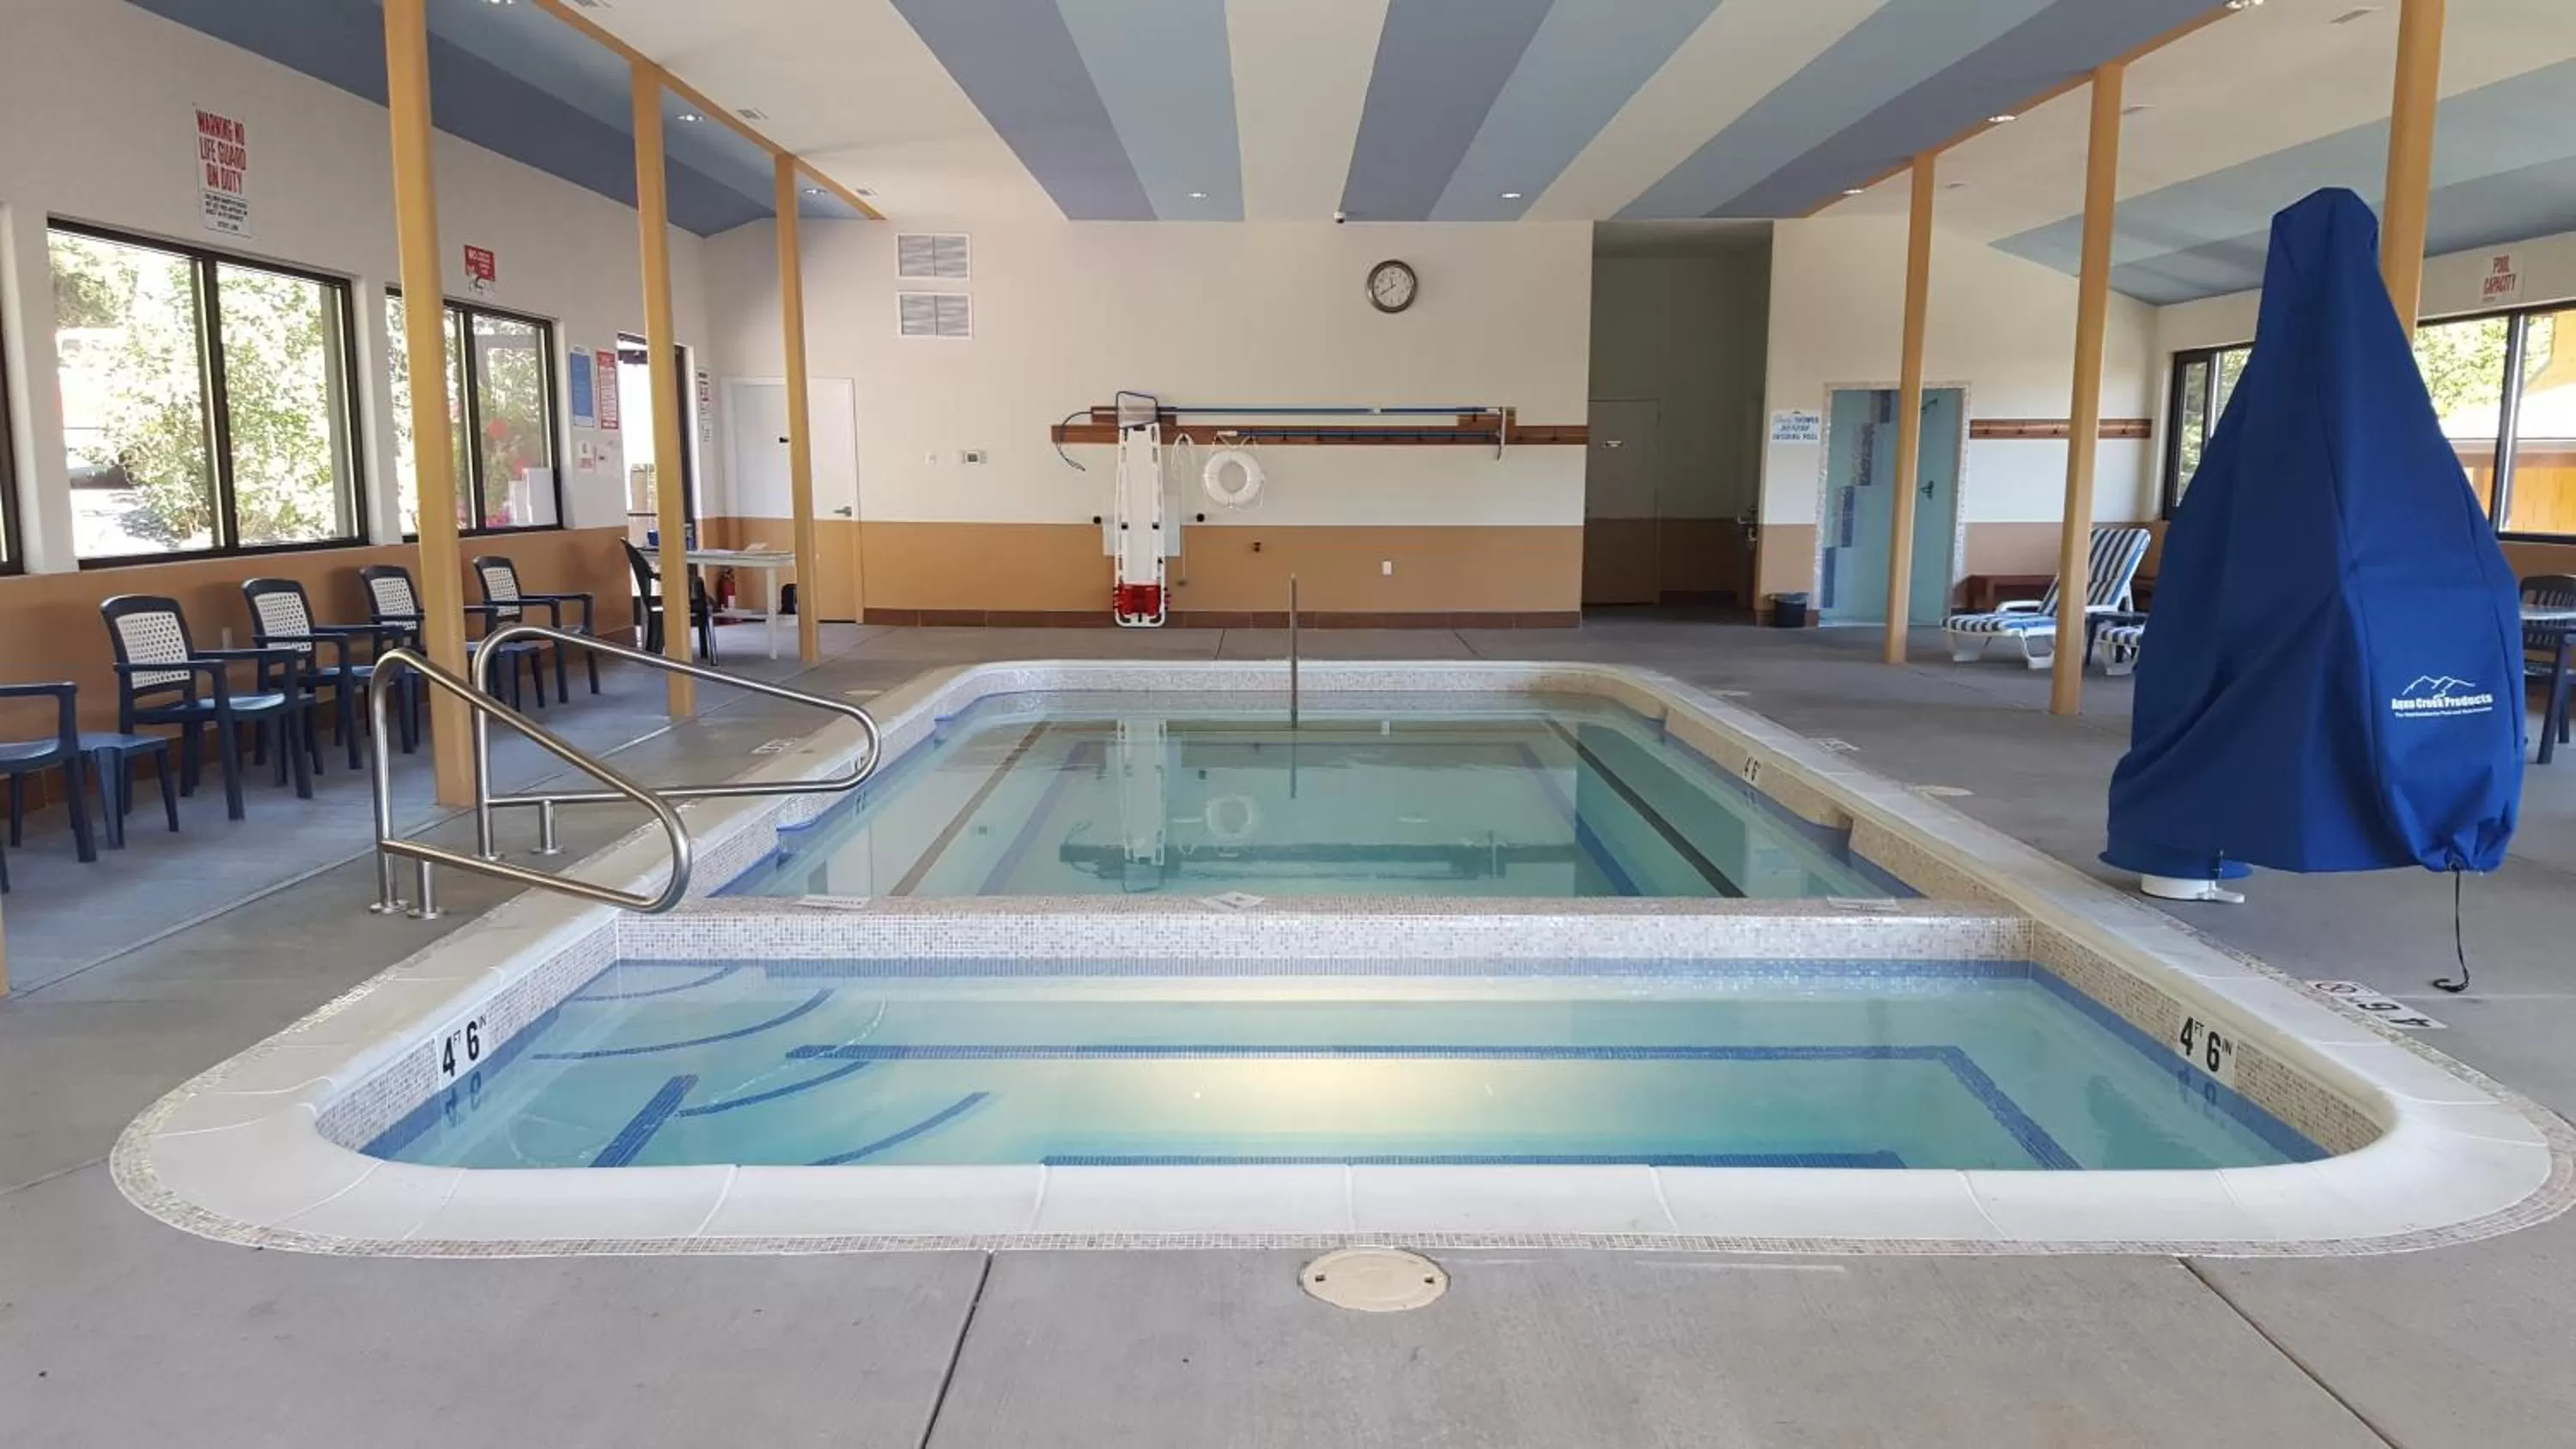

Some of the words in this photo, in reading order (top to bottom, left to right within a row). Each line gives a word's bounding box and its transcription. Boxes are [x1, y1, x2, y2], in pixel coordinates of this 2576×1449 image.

[196, 109, 232, 142] WARNING
[234, 121, 245, 146] NO
[199, 137, 216, 162] LIFE
[217, 141, 246, 171] GUARD
[206, 162, 219, 187] ON
[221, 167, 242, 195] DUTY
[2391, 698, 2415, 711] Aqua
[2445, 694, 2494, 708] Products
[442, 1036, 455, 1076] 4
[466, 1020, 480, 1061] 6
[2180, 1016, 2194, 1057] 4
[2206, 1031, 2221, 1072] 6
